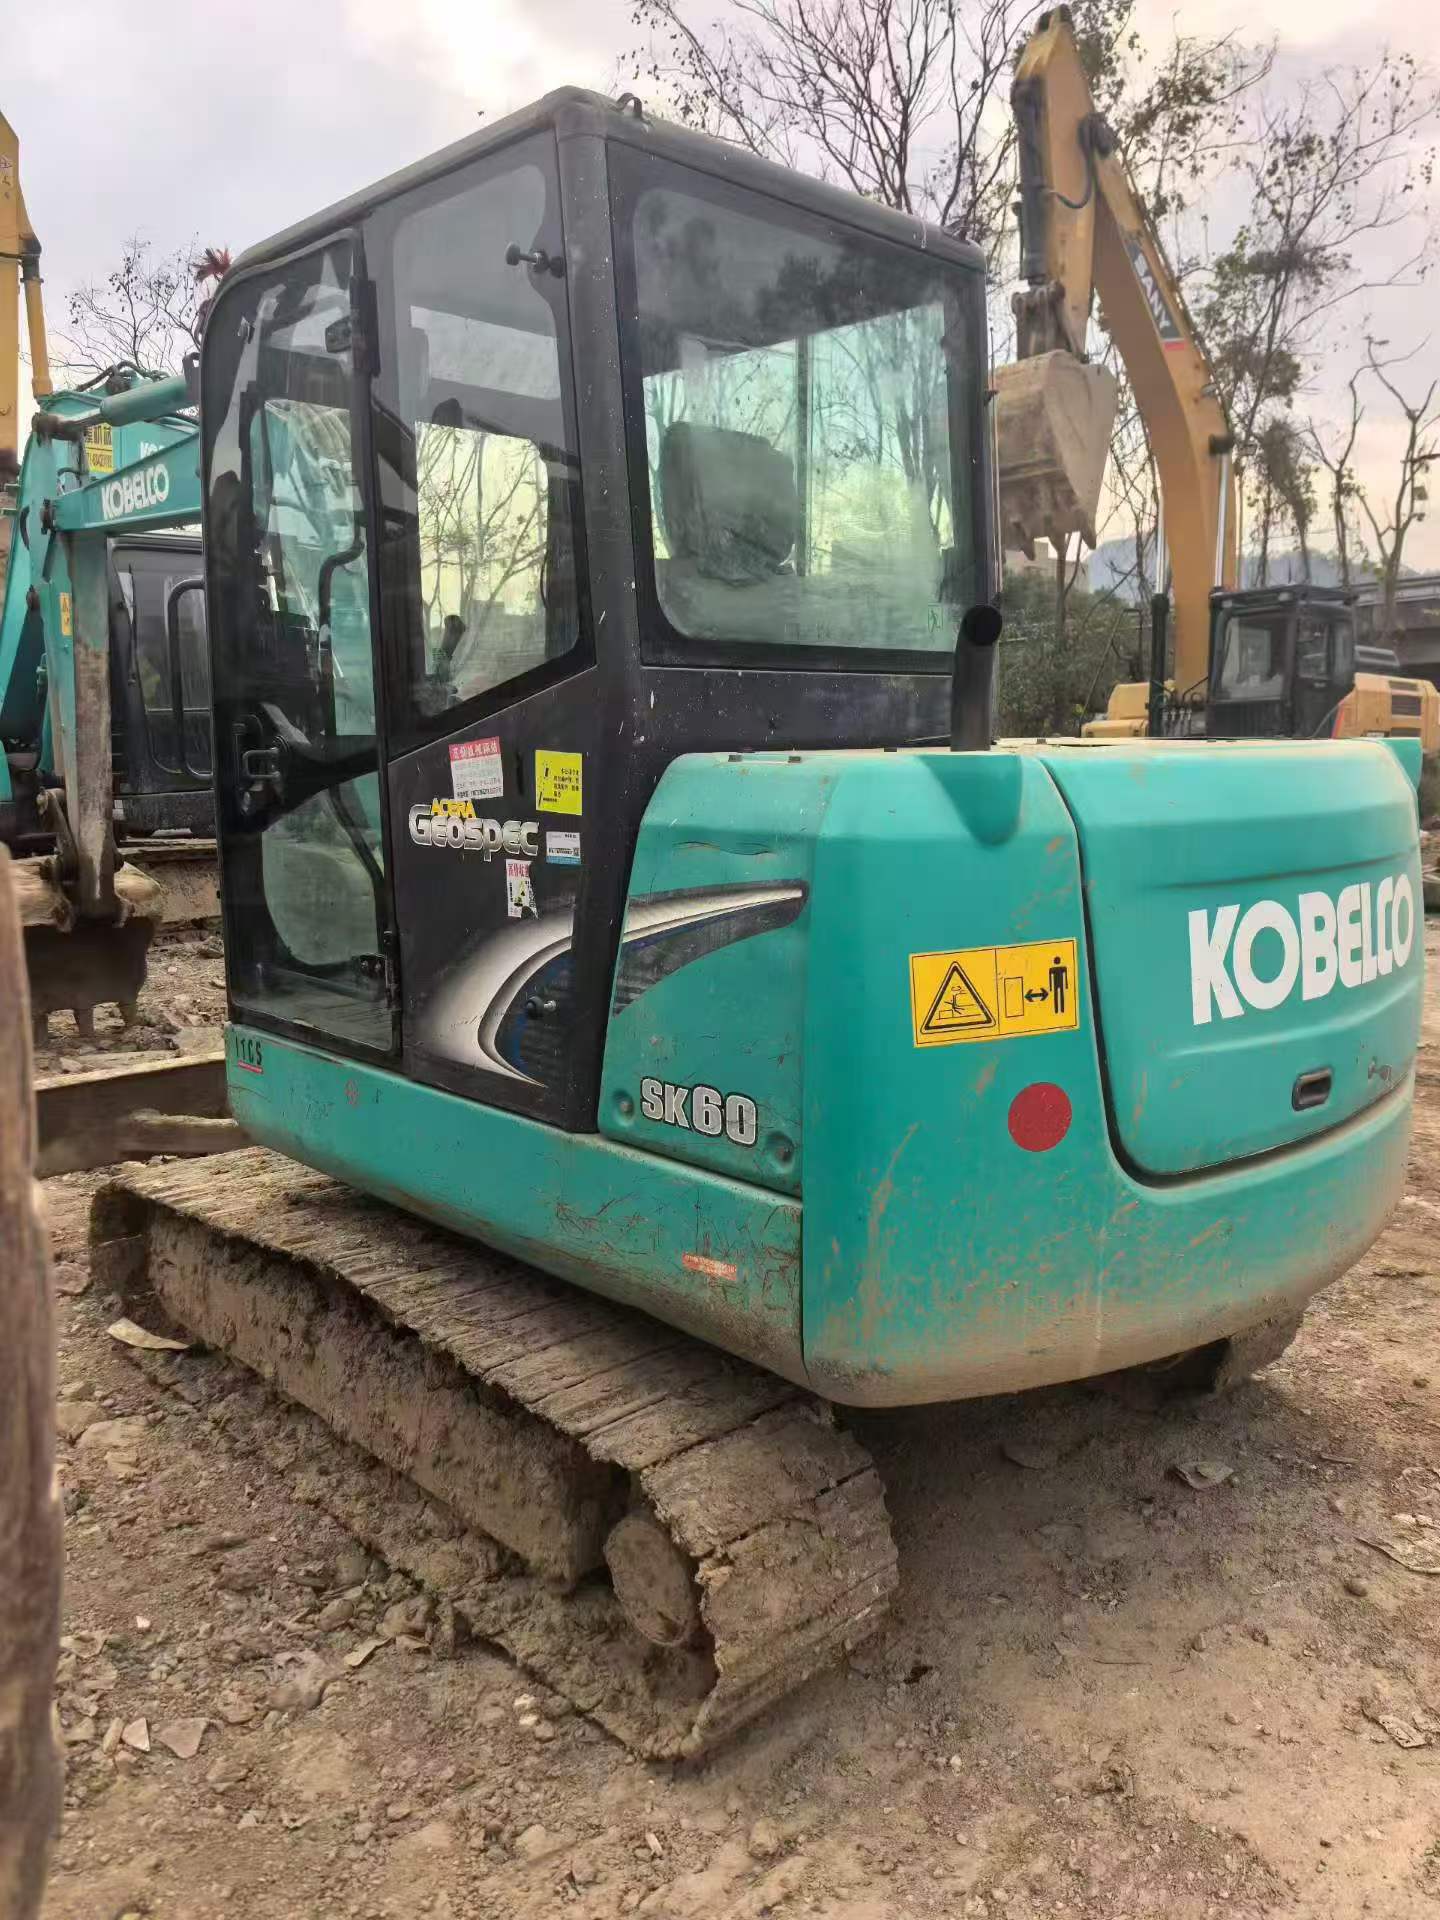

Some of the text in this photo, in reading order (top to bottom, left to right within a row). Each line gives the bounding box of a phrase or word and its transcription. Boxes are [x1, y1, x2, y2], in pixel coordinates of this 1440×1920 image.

[102, 463, 169, 520] KOBELCO
[1188, 873, 1414, 1026] KOBELCO
[640, 1076, 758, 1147] SK60
